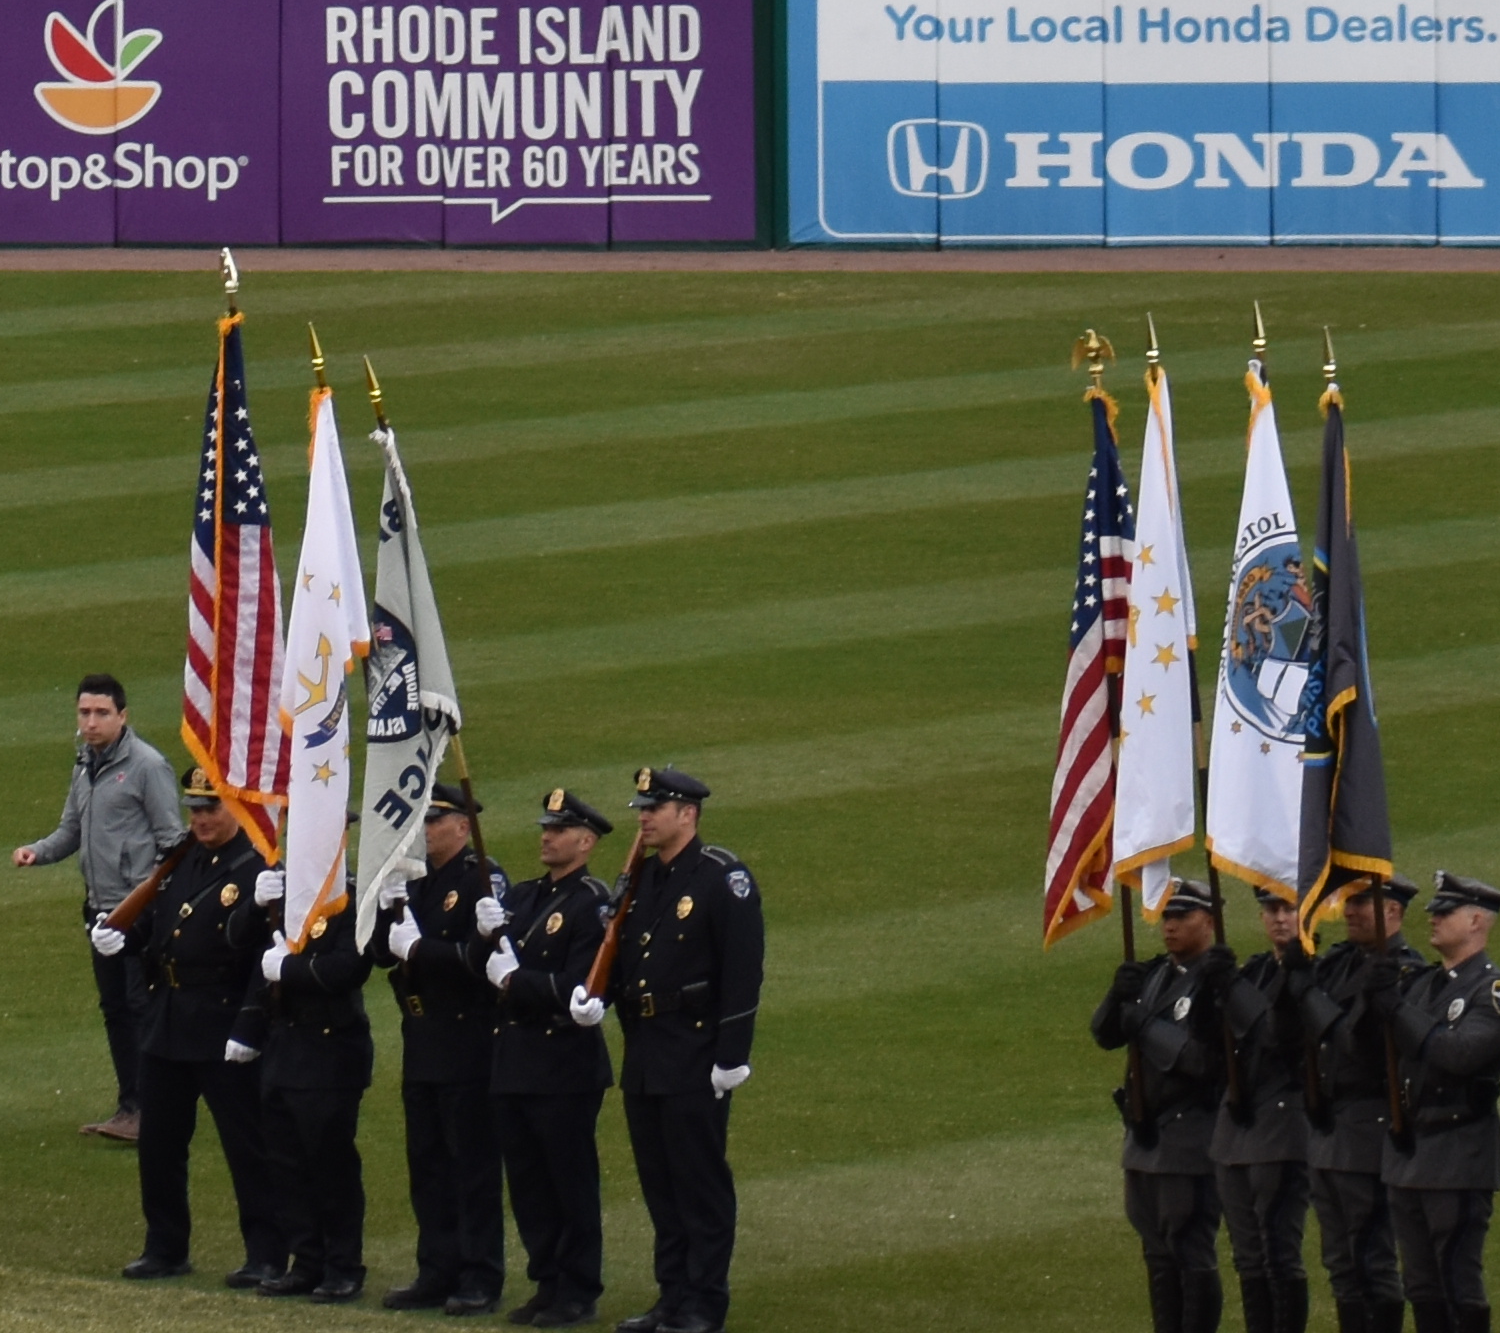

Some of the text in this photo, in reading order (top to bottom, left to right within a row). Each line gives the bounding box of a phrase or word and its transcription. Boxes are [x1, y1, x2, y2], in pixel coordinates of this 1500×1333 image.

[326, 3, 701, 65] RHODE ISLAND
[885, 4, 1498, 44] Your Local Honda Dealers.
[328, 69, 704, 140] COMMUNITY
[330, 143, 701, 188] FOR OVER 60 YEARS
[1005, 132, 1485, 190] HONDA
